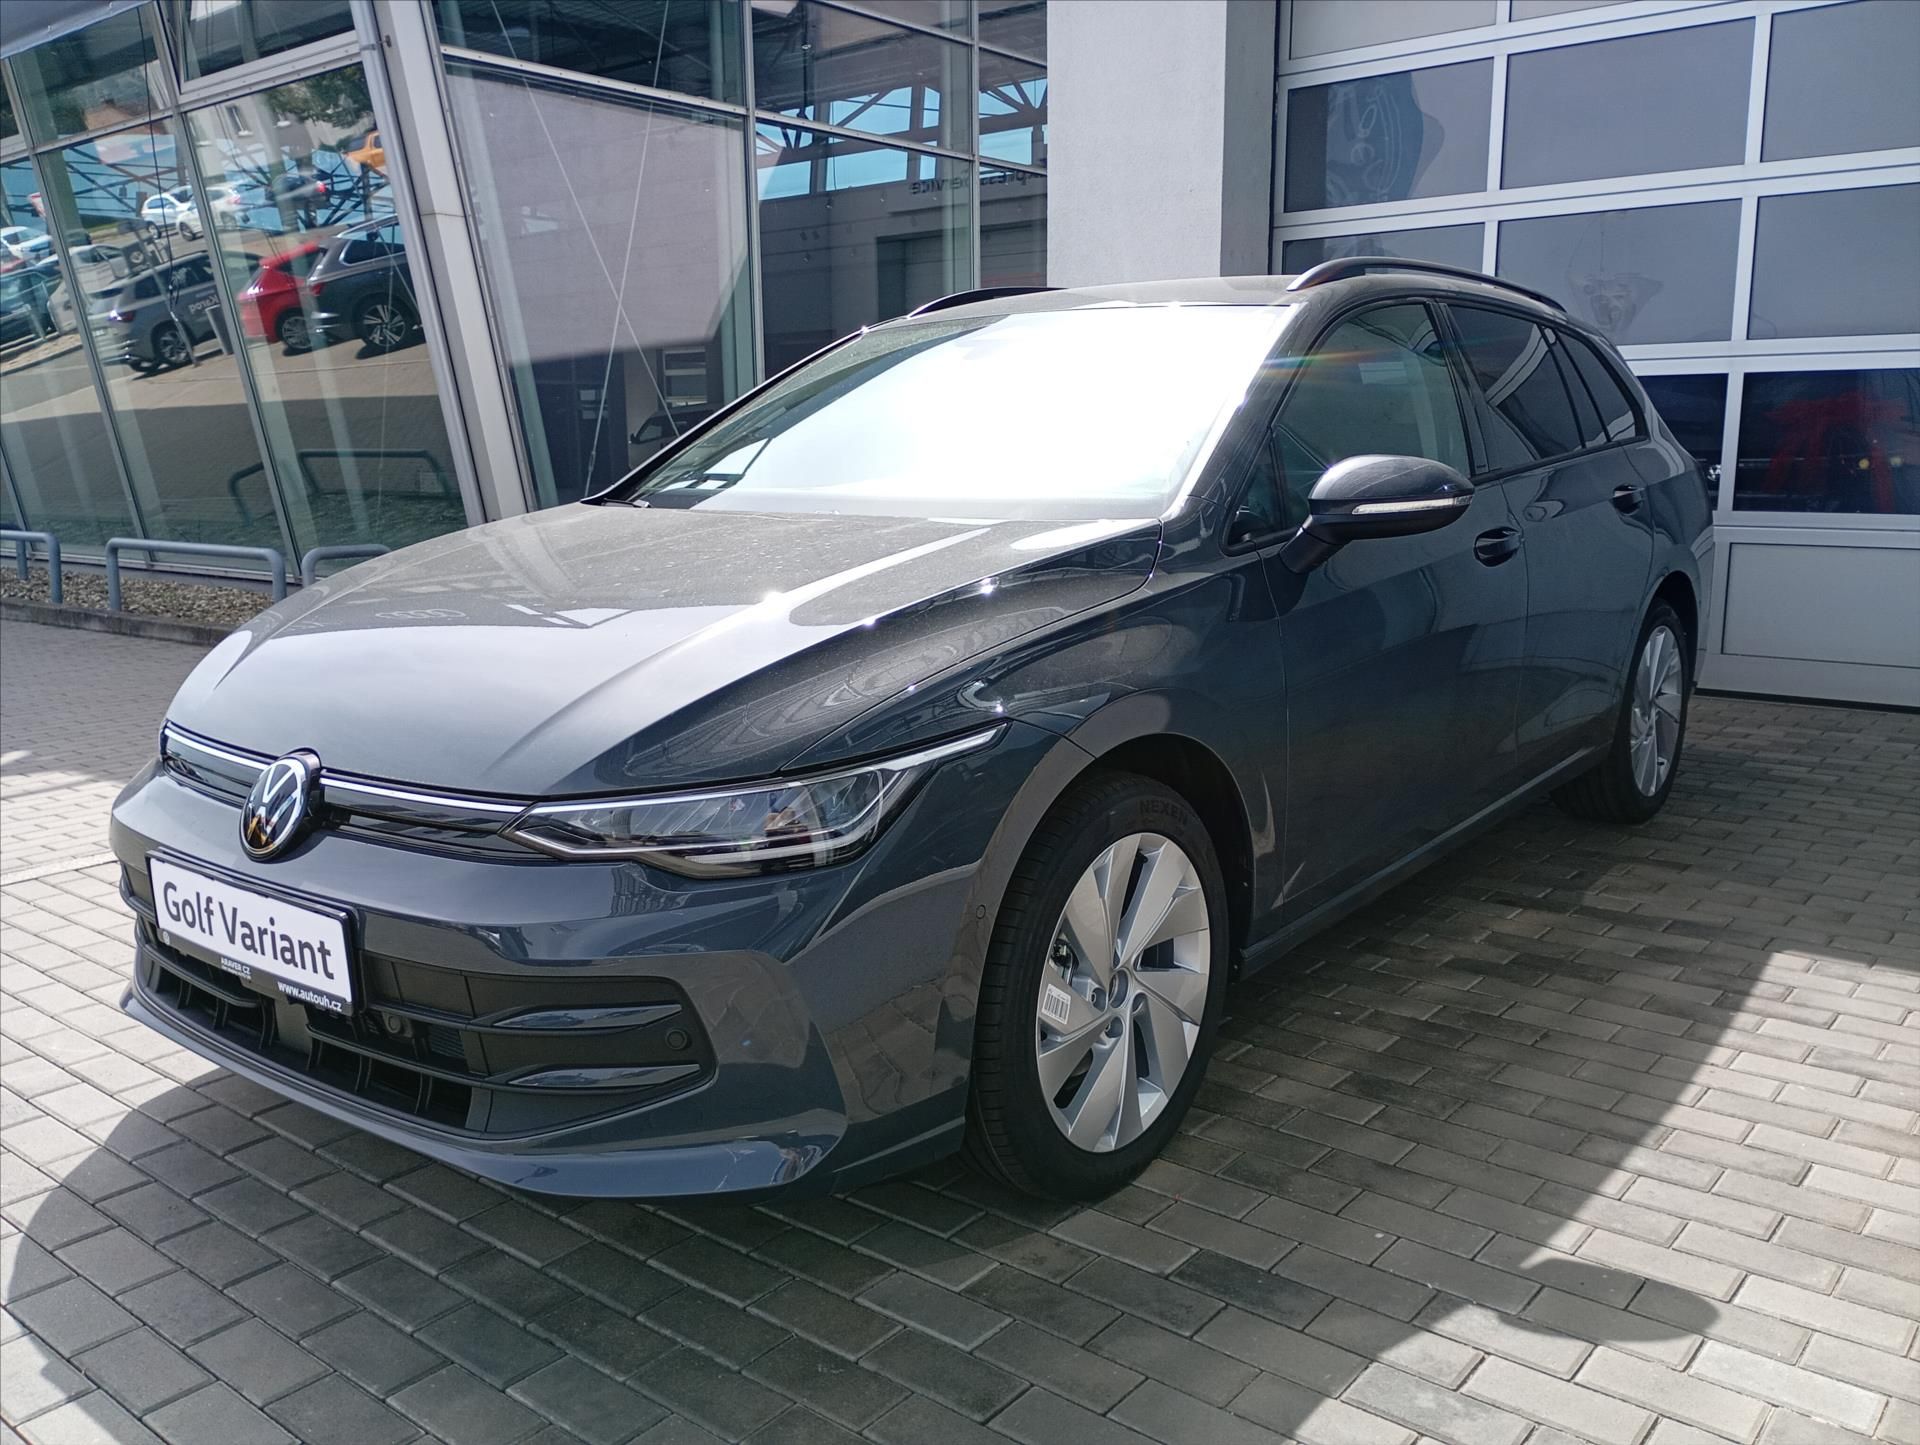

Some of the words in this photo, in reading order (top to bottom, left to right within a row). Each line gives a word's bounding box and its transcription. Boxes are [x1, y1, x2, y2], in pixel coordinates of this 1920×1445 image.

[163, 881, 214, 936] Golf
[218, 901, 335, 980] Variant
[277, 981, 342, 1012] www.autouh.cz
